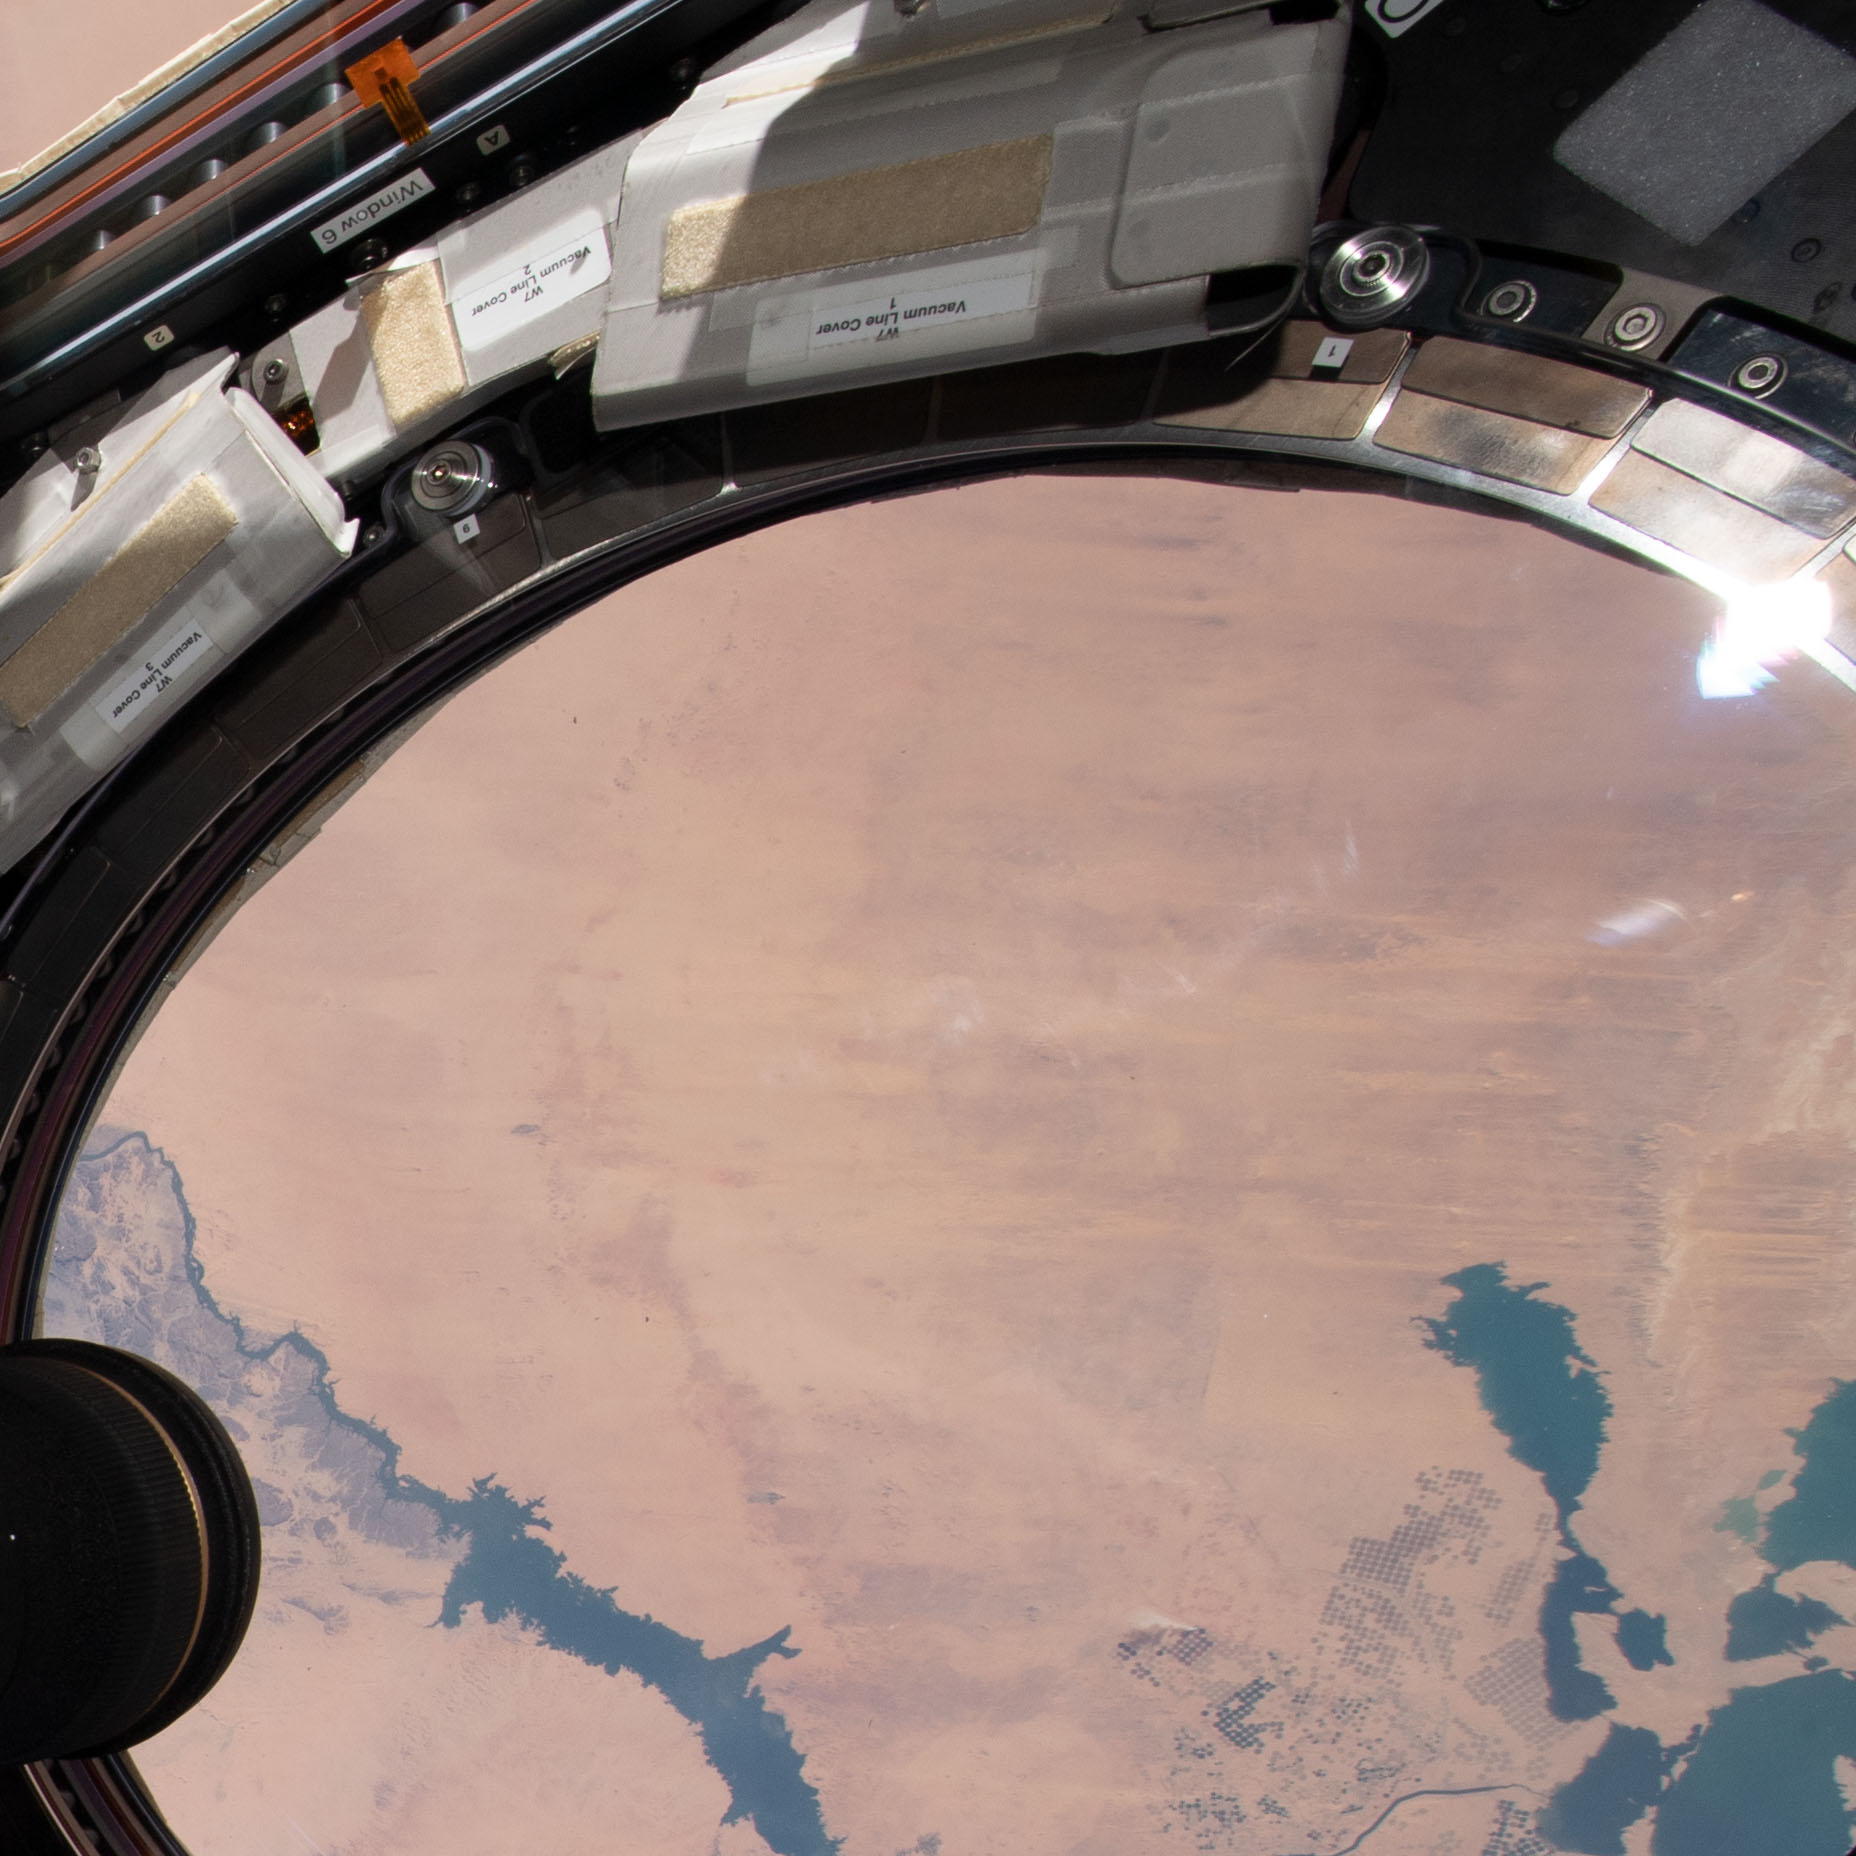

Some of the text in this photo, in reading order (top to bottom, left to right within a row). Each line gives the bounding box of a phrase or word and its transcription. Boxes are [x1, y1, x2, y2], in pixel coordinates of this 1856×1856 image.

[482, 130, 502, 148] A
[319, 176, 424, 246] Window 6
[520, 263, 533, 276] 2
[470, 245, 591, 317] Vacuum Line Cover
[520, 284, 544, 303] W7
[887, 296, 897, 309] 1
[815, 299, 966, 335] Vacuum Line Cover
[150, 329, 166, 345] 2
[1327, 343, 1337, 358] 1
[110, 630, 202, 718] Vacuum Line Cover
[143, 661, 154, 672] 3
[153, 673, 173, 693] W7
